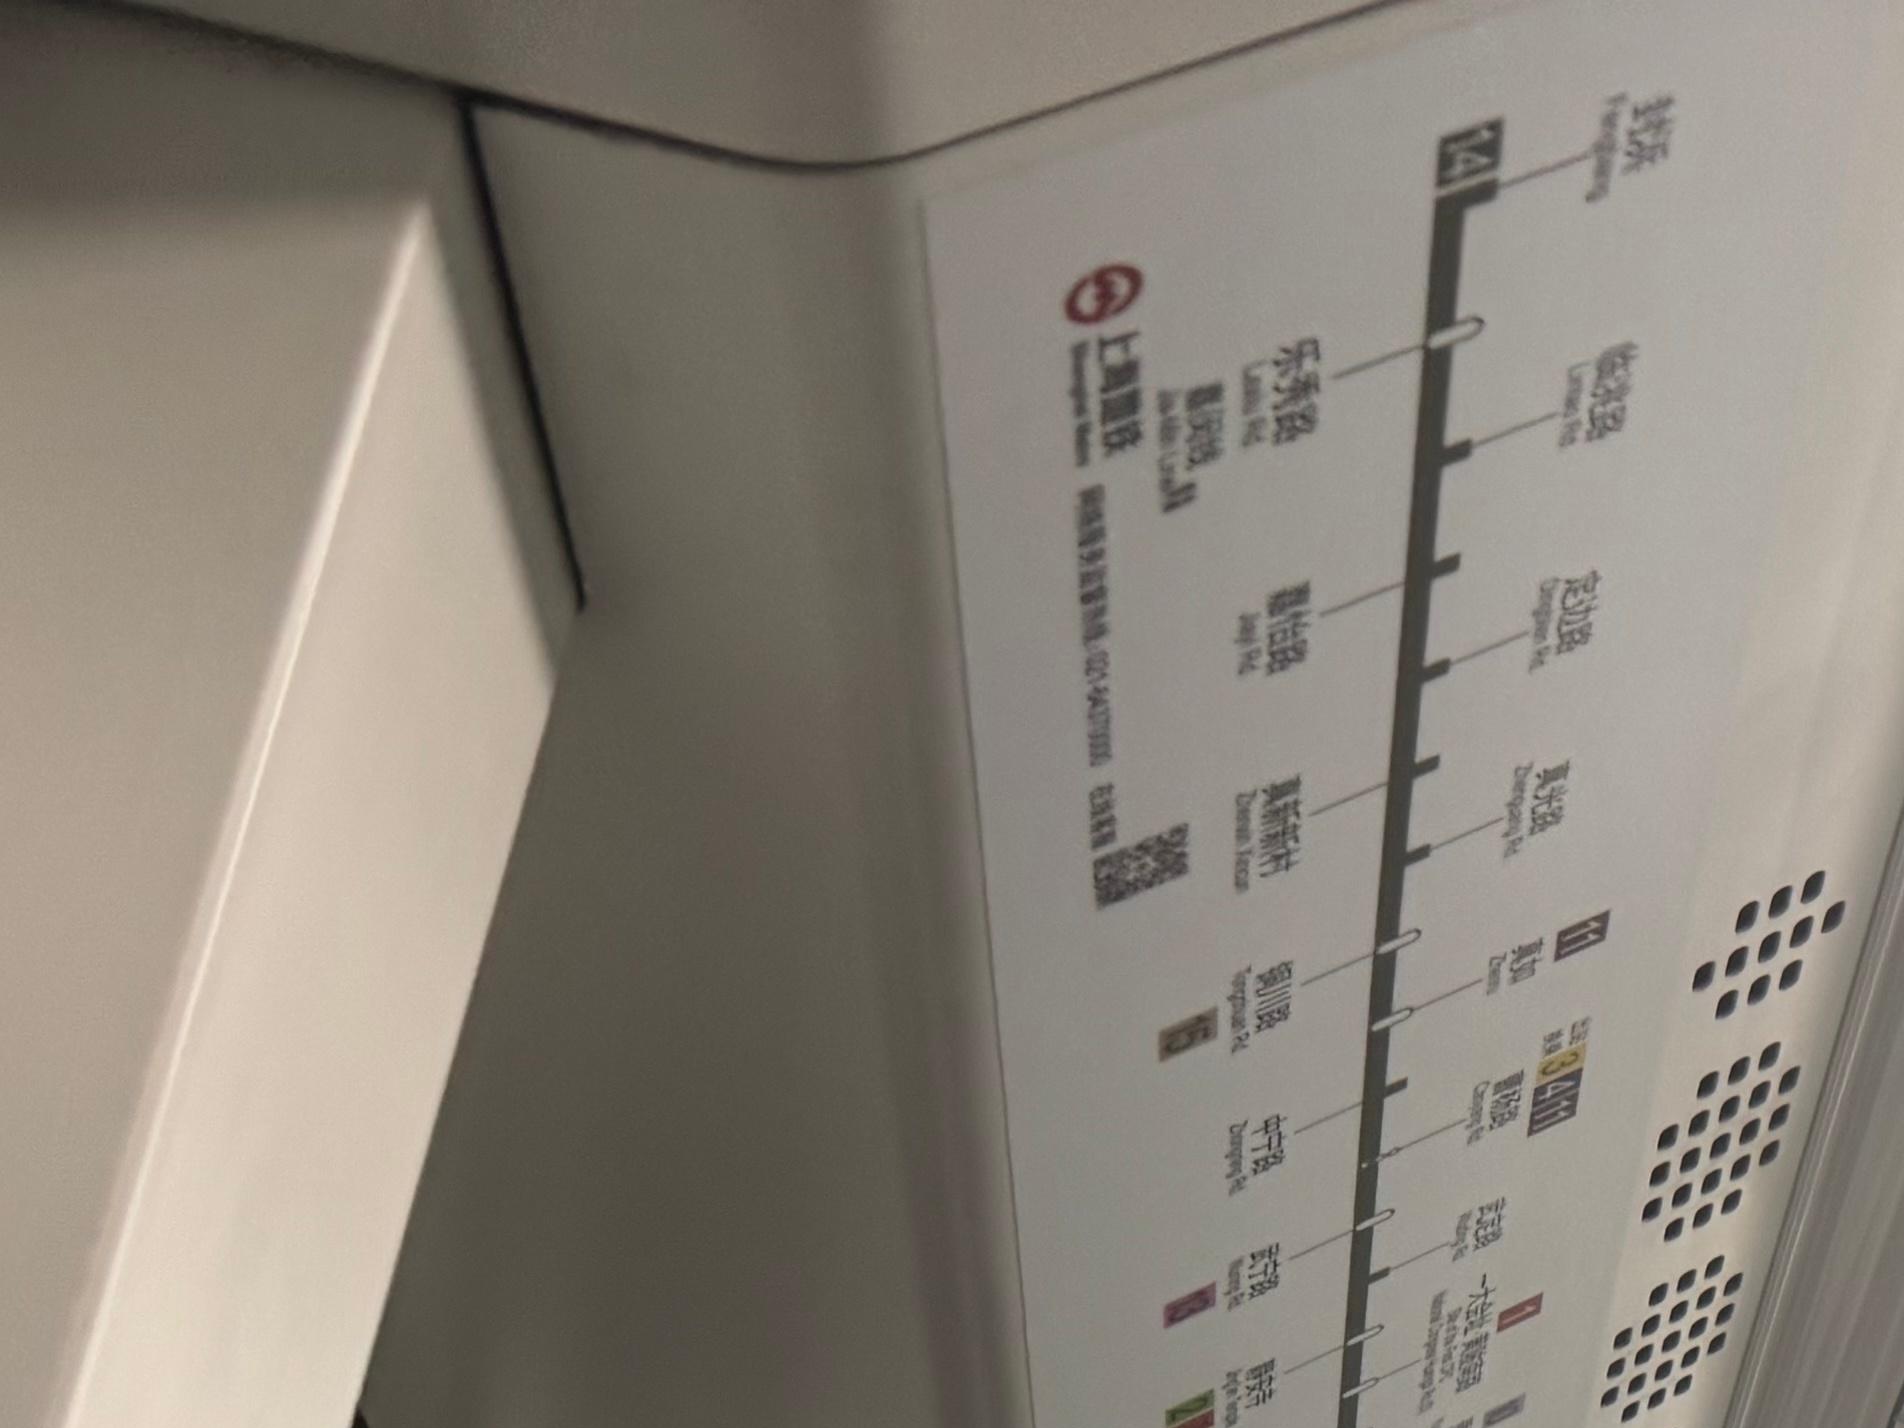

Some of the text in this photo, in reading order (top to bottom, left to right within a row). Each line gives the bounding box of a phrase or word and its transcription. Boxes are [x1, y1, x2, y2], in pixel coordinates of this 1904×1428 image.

[1440, 125, 1497, 184] 14
[1270, 331, 1323, 451] 乐秀路
[1551, 564, 1604, 660] 定边路
[1258, 772, 1302, 883] 真新新村
[1526, 757, 1570, 838] 真光路
[1506, 934, 1543, 988] 真如
[1558, 913, 1604, 958] 11
[1253, 957, 1294, 1036] 铜川路
[1248, 1109, 1287, 1180] 中宁路
[1246, 1238, 1281, 1302] 武宁路
[1243, 1356, 1275, 1413] 静安寺
